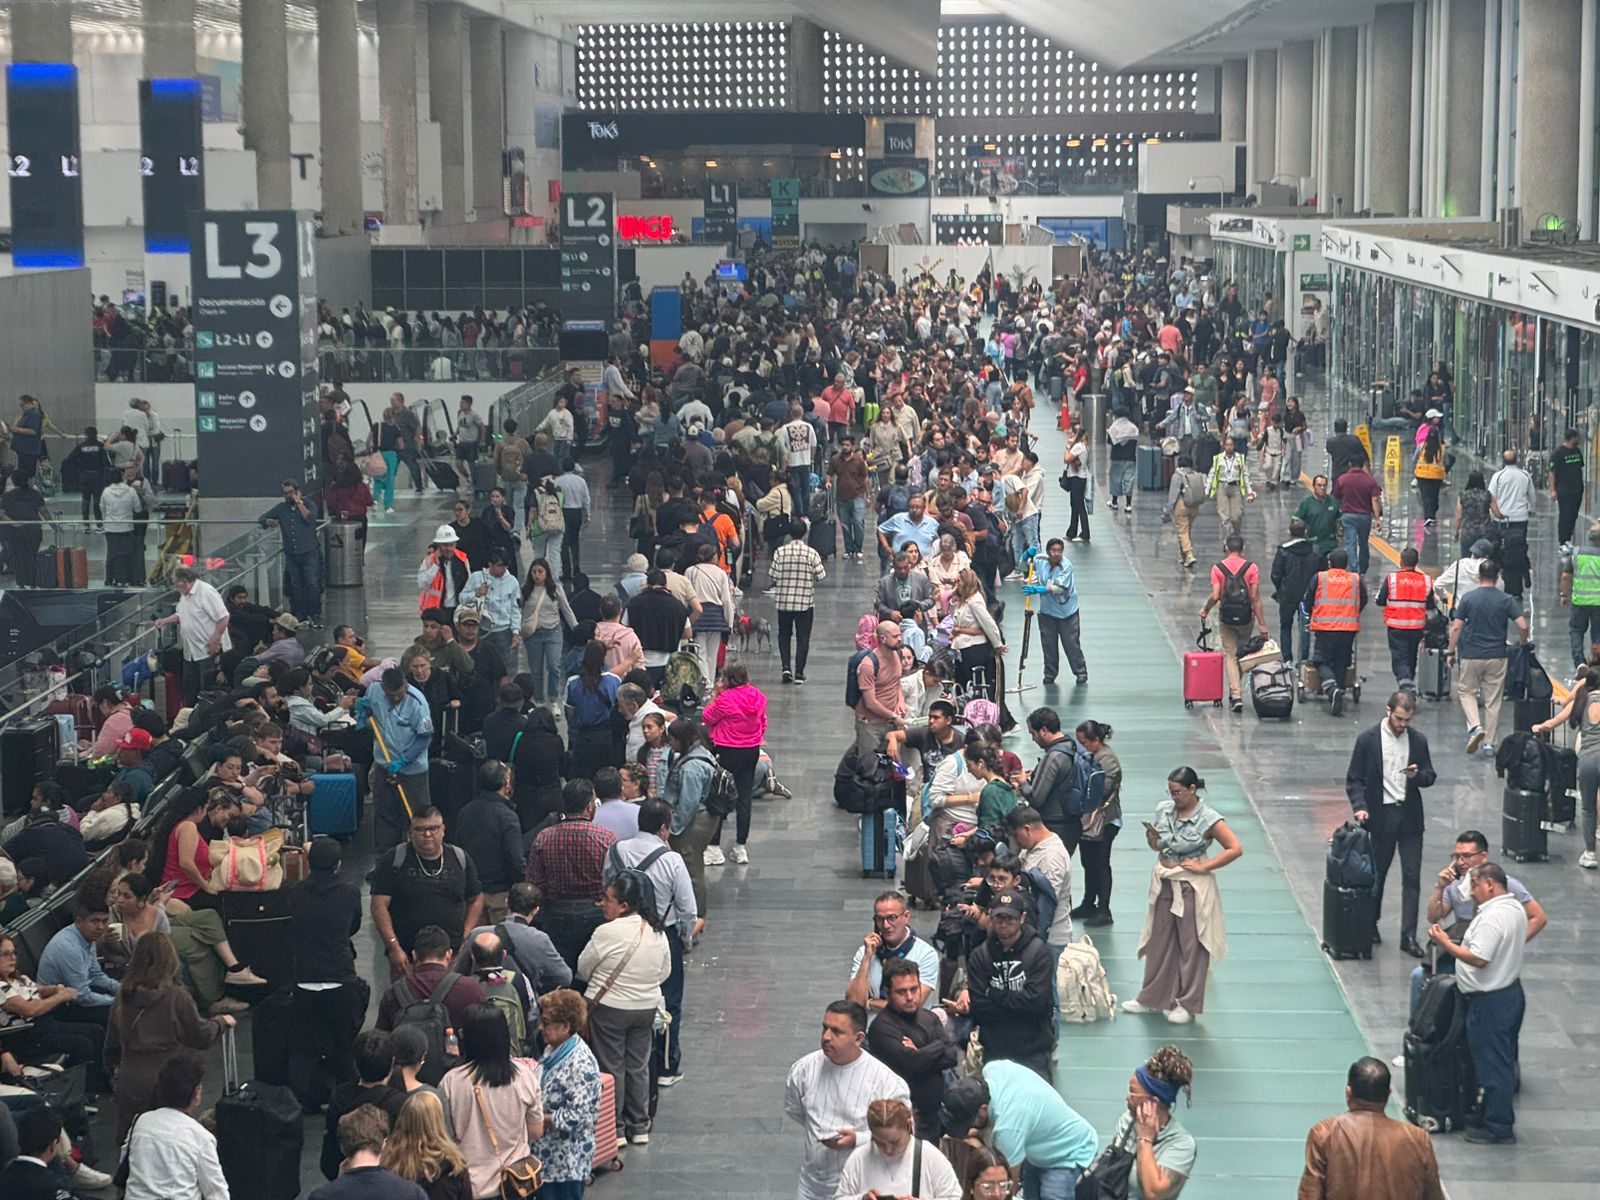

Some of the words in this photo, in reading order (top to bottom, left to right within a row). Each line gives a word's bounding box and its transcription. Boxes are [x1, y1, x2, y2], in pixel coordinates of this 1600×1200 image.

[711, 185, 730, 203] L1
[778, 182, 790, 196] K
[567, 197, 606, 227] L2
[616, 215, 672, 240] INGS
[205, 222, 281, 278] L3
[216, 333, 251, 346] L2-L1
